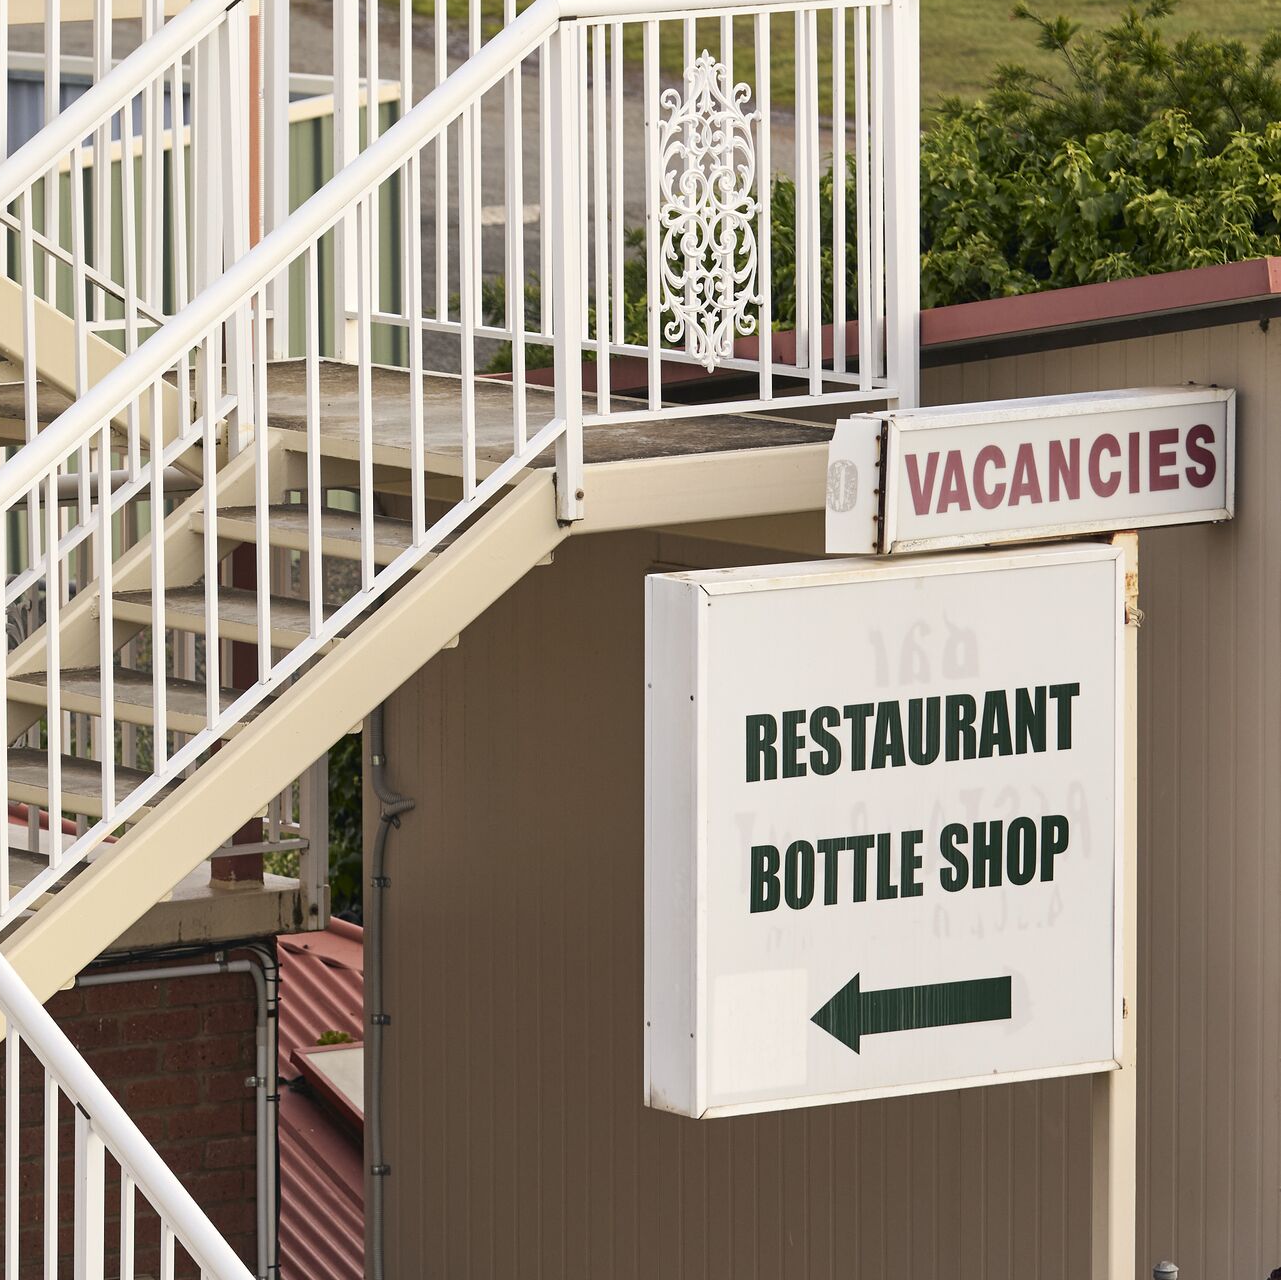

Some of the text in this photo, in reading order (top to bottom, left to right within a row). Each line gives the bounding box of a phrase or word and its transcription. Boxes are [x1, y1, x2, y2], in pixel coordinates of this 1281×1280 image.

[905, 424, 1217, 516] VACANCIES
[745, 682, 1080, 783] RESTAURANT
[750, 814, 1070, 914] BOTTLE SHOP
